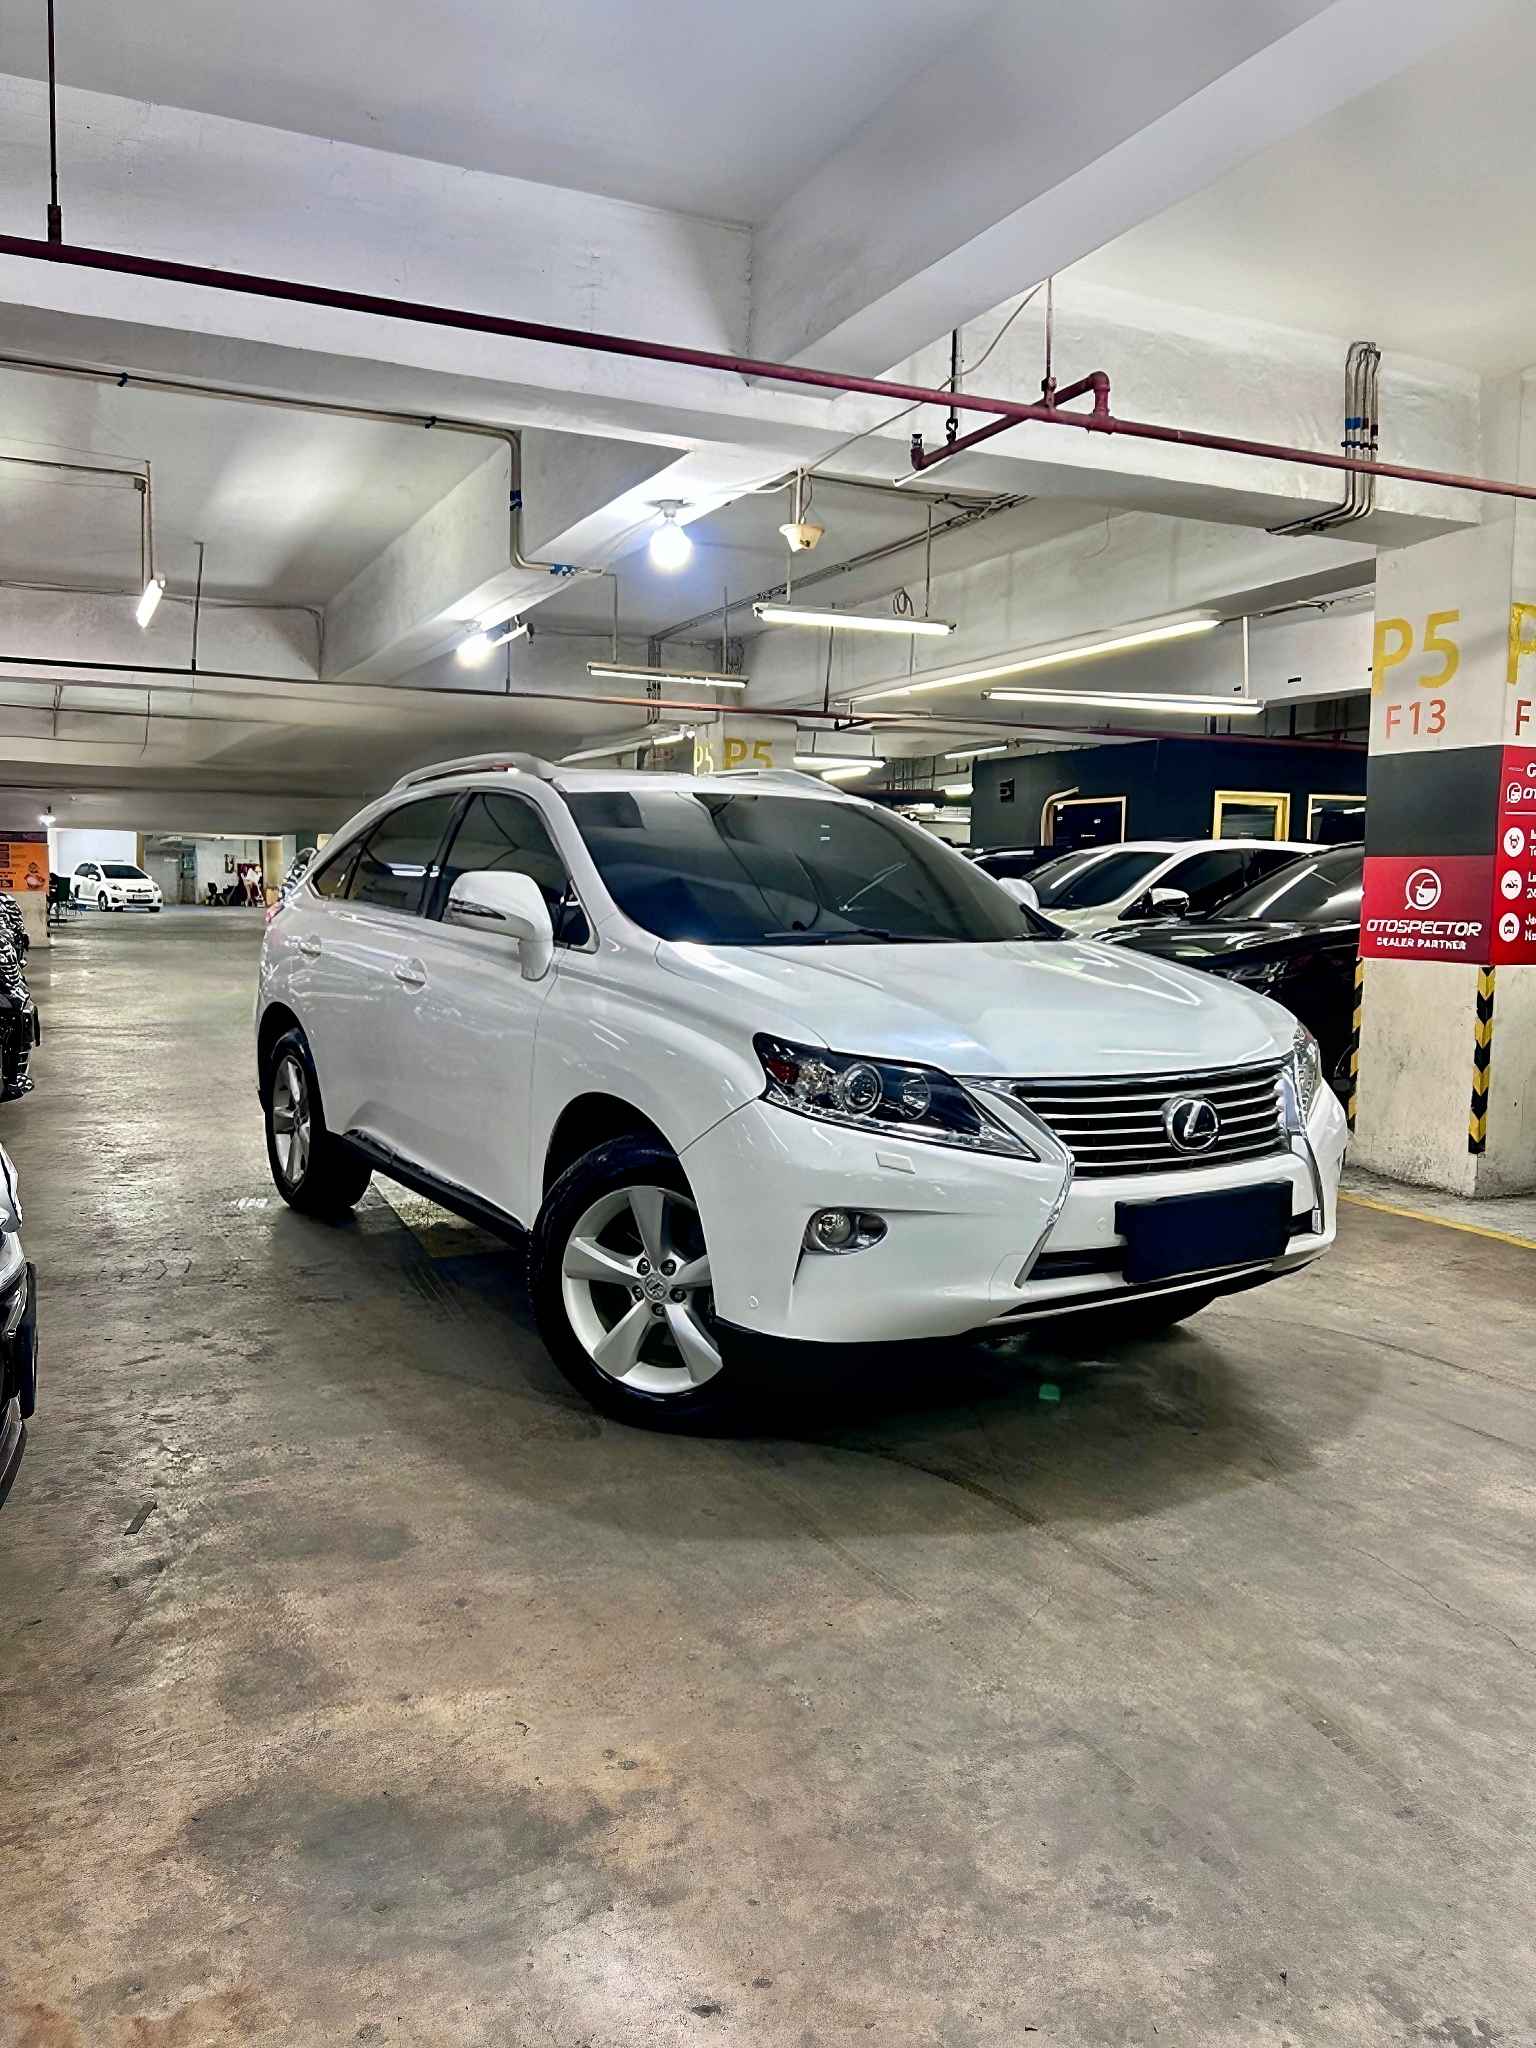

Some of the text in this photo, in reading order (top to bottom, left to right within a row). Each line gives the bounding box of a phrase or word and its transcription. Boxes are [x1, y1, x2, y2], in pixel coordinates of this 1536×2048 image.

[1370, 608, 1460, 697] P5
[1385, 698, 1447, 739] F13
[693, 743, 714, 776] P5
[723, 737, 774, 769] P5
[1366, 919, 1482, 937] OTOSPECTOR
[1376, 937, 1467, 950] DEALER PARTNER
